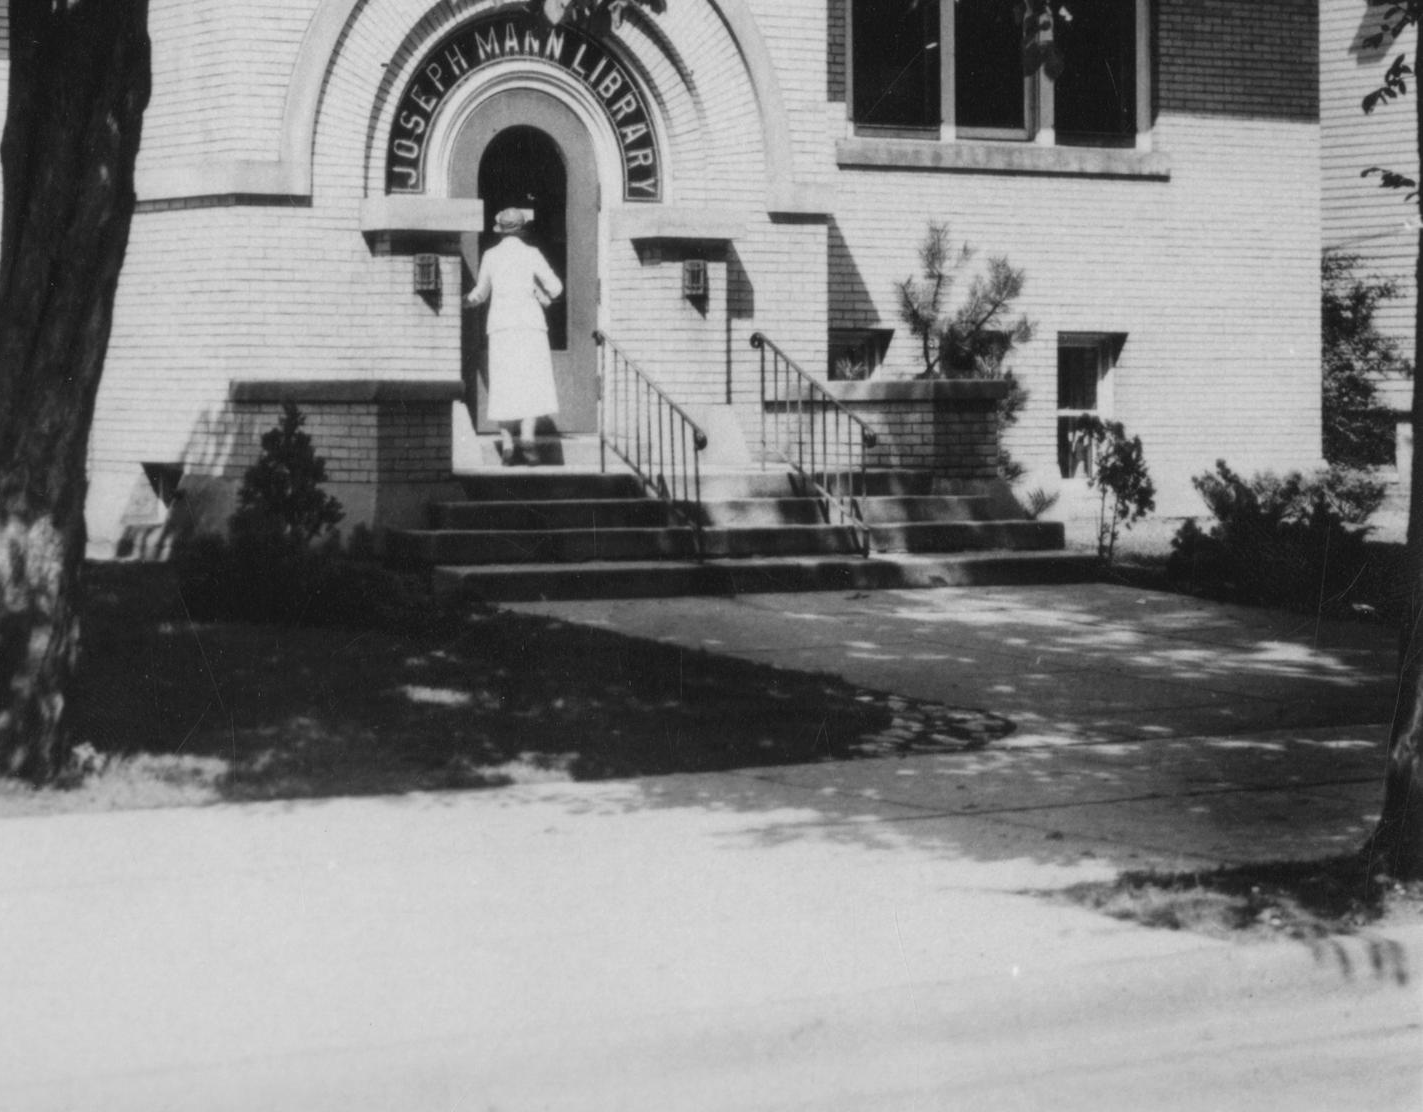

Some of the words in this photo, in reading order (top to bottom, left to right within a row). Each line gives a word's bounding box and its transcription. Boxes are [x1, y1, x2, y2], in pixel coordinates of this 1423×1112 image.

[392, 43, 469, 186] JOSEPH
[474, 22, 565, 60] MANN
[572, 43, 657, 194] LIBRARY
